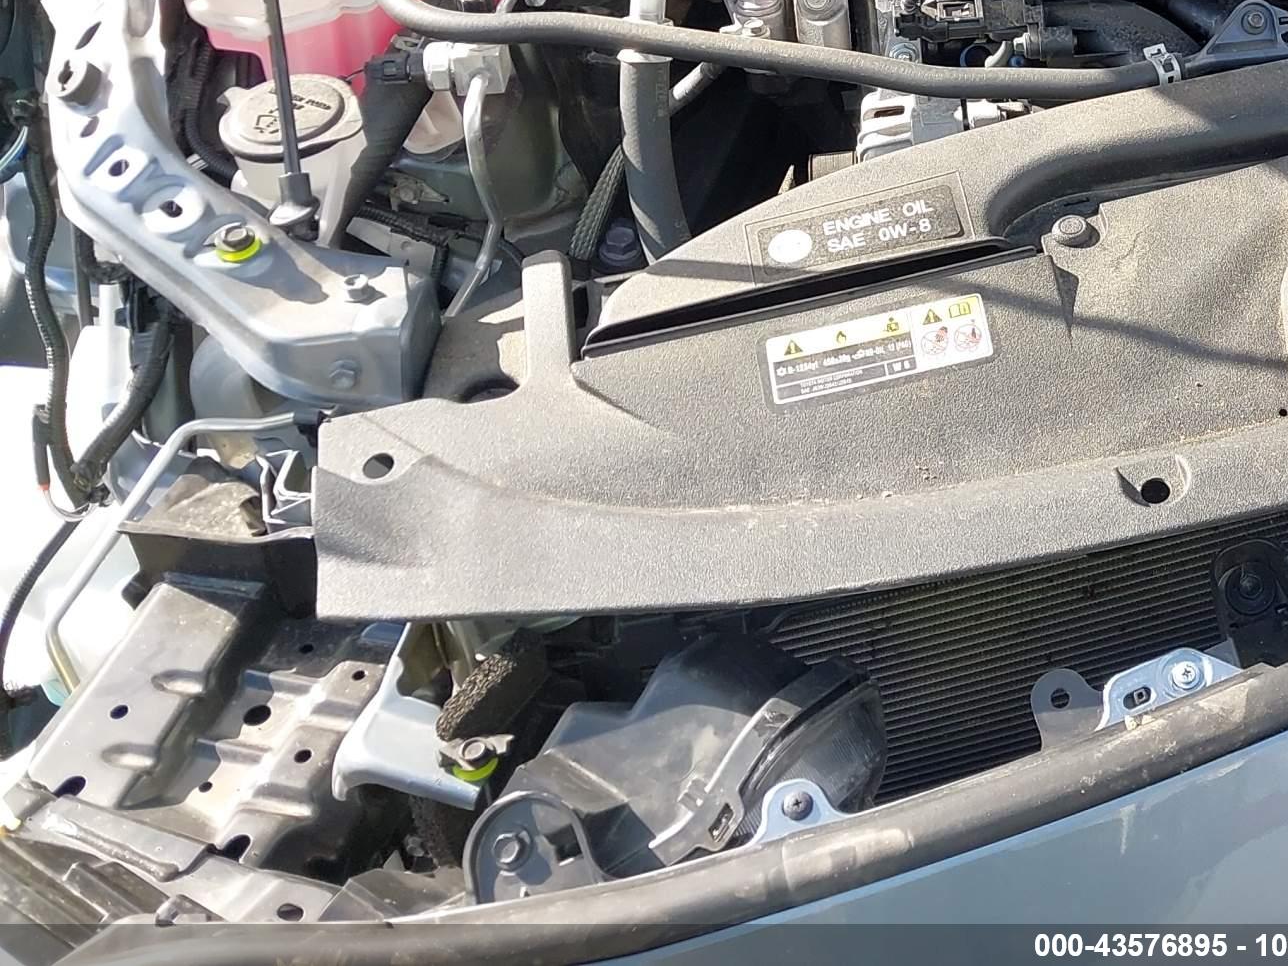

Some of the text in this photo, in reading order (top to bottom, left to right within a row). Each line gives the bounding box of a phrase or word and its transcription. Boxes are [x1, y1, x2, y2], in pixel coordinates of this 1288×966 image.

[823, 199, 934, 236] ENGINE OIL
[827, 218, 932, 253] SAE 0W-8
